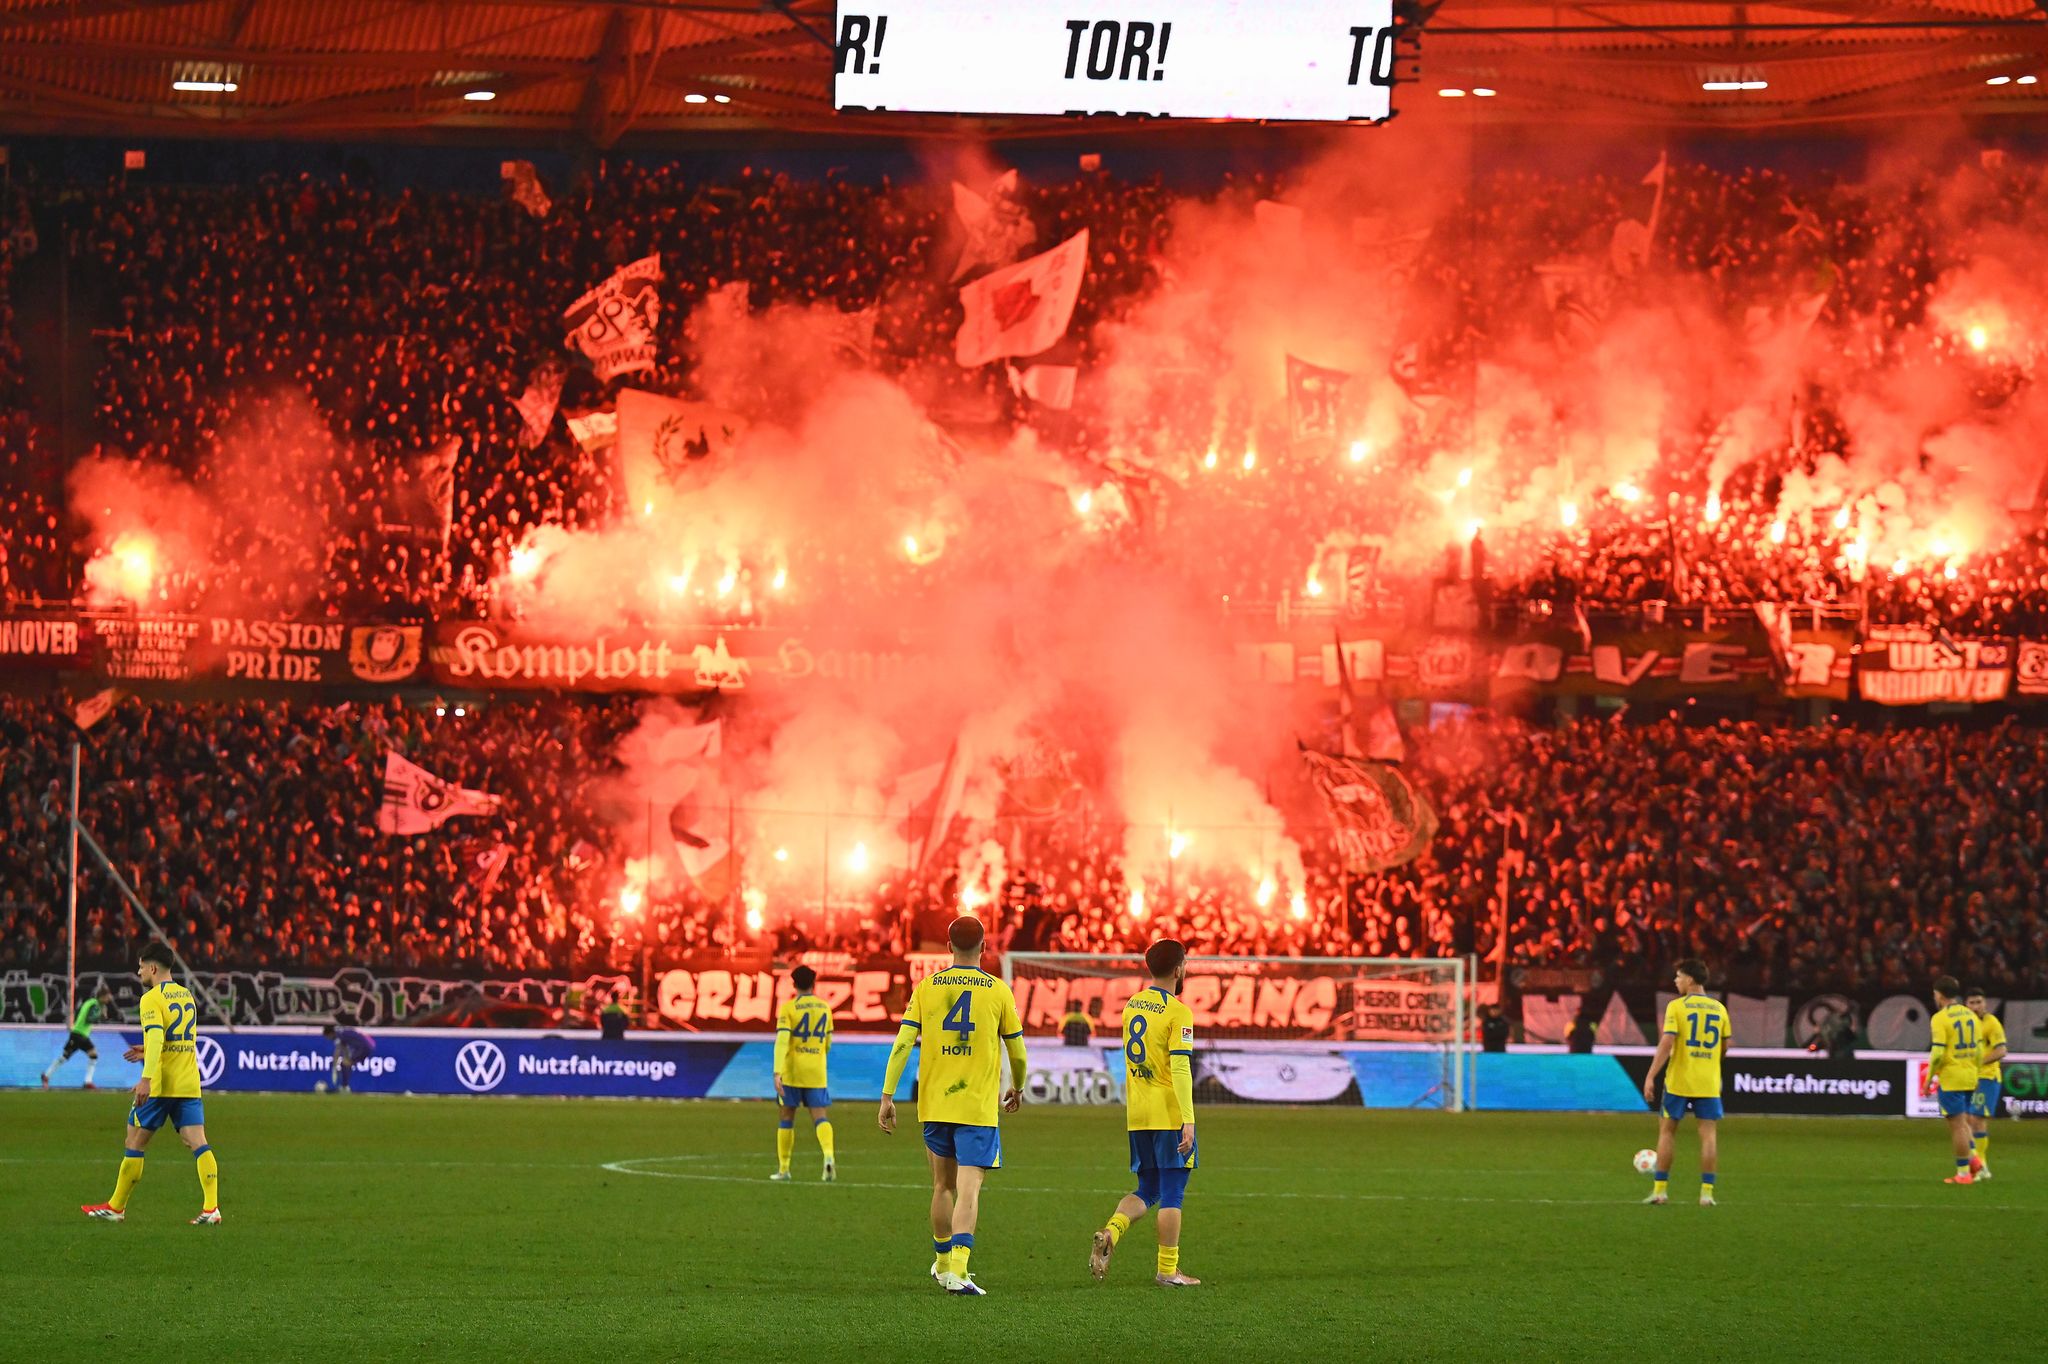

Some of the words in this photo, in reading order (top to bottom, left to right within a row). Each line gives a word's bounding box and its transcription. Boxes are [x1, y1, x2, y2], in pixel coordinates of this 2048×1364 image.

[1064, 20, 1173, 81] TOR!
[0, 620, 79, 655] NOVER
[210, 617, 344, 651] PASSION
[226, 648, 321, 682] PRIDE
[450, 626, 673, 685] Komplott
[1888, 639, 1982, 672] WEST
[932, 975, 994, 989] BRAUNSCHWEIG
[165, 1002, 197, 1042] 22
[942, 990, 976, 1042] 4
[1126, 999, 1166, 1015] AUNSCHWEIG
[792, 1011, 828, 1044] 44
[1126, 1014, 1148, 1065] 8
[1685, 1012, 1721, 1049] 15
[1953, 1018, 1977, 1050] 11
[238, 1049, 397, 1077] Nutzfahruge
[941, 1045, 972, 1056] HOTI
[518, 1054, 677, 1081] Nutzfahrzeuge
[1734, 1072, 1891, 1100] Nutzfahrzeuge
